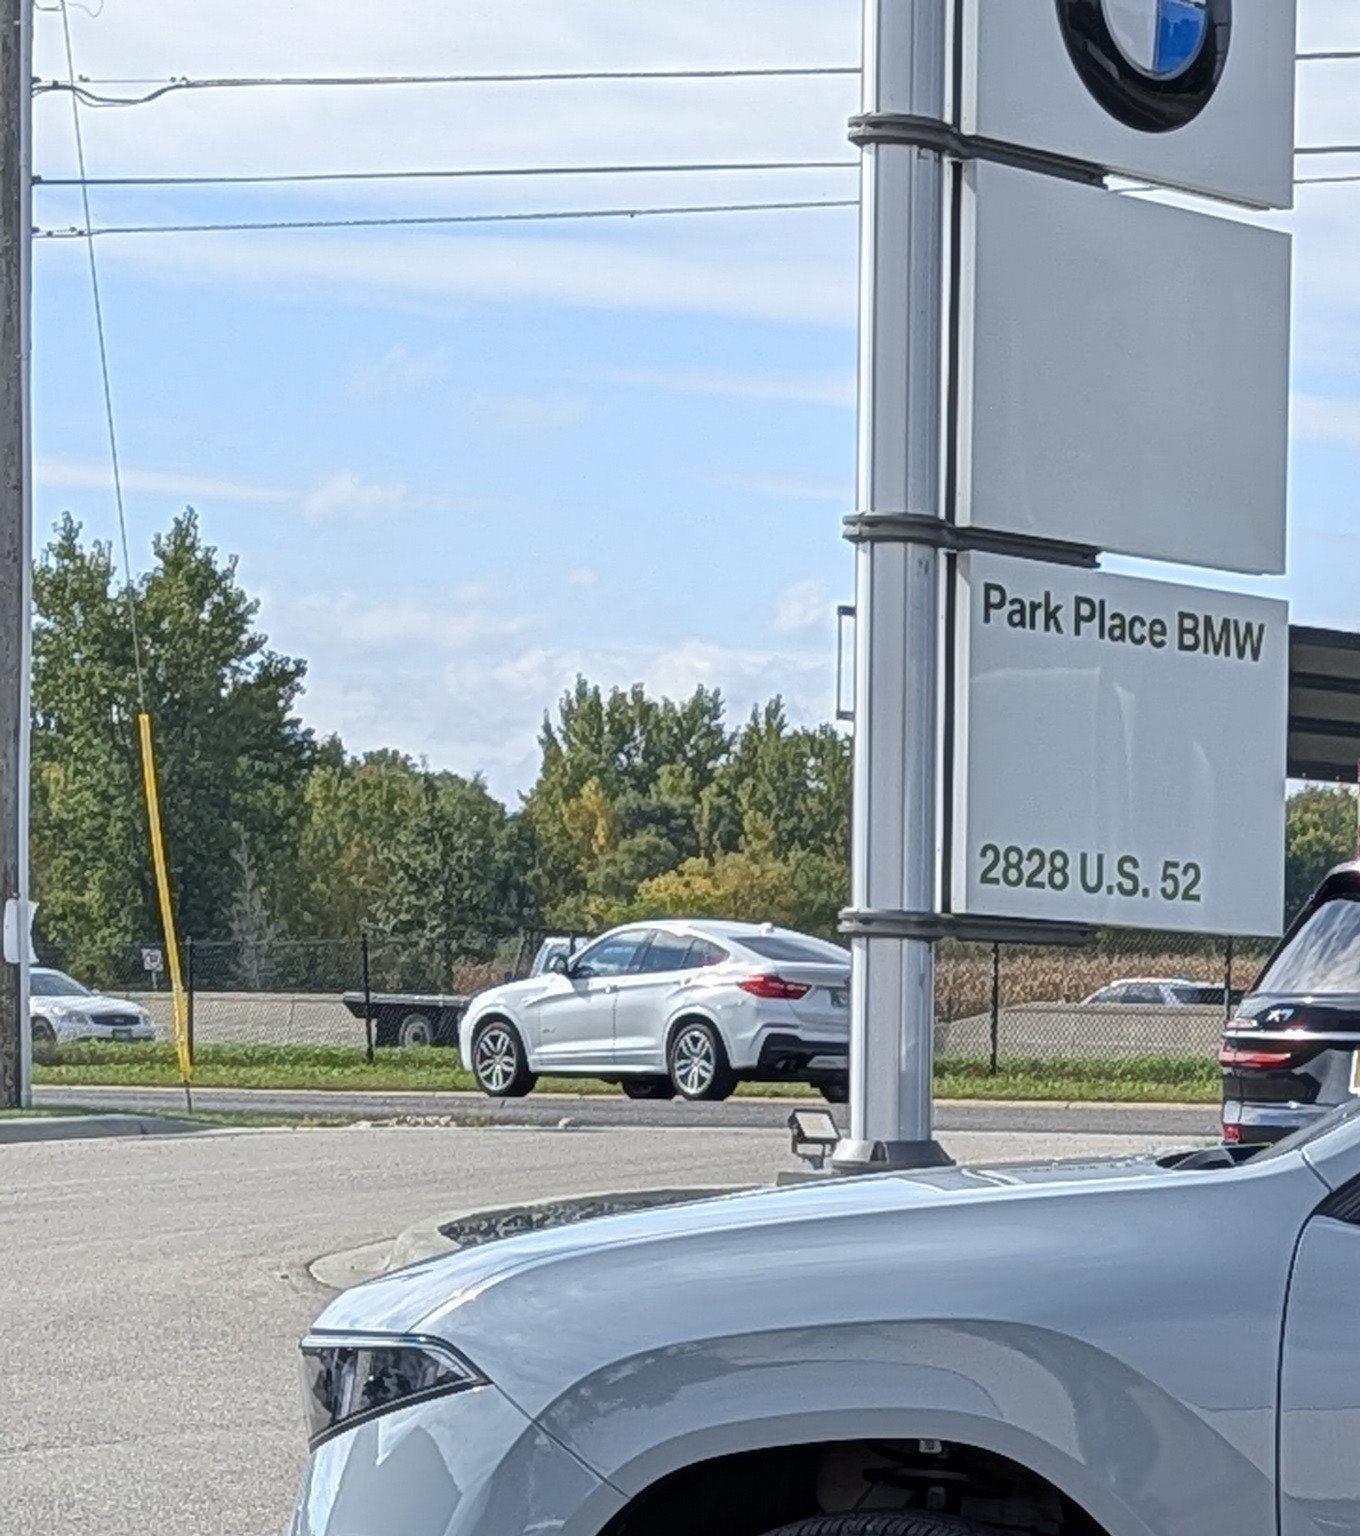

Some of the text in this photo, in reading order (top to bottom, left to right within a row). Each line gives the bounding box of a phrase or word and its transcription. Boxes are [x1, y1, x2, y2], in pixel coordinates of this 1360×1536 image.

[982, 582, 1265, 662] Park Place BMW
[979, 843, 1201, 902] 2828 U.S. 52
